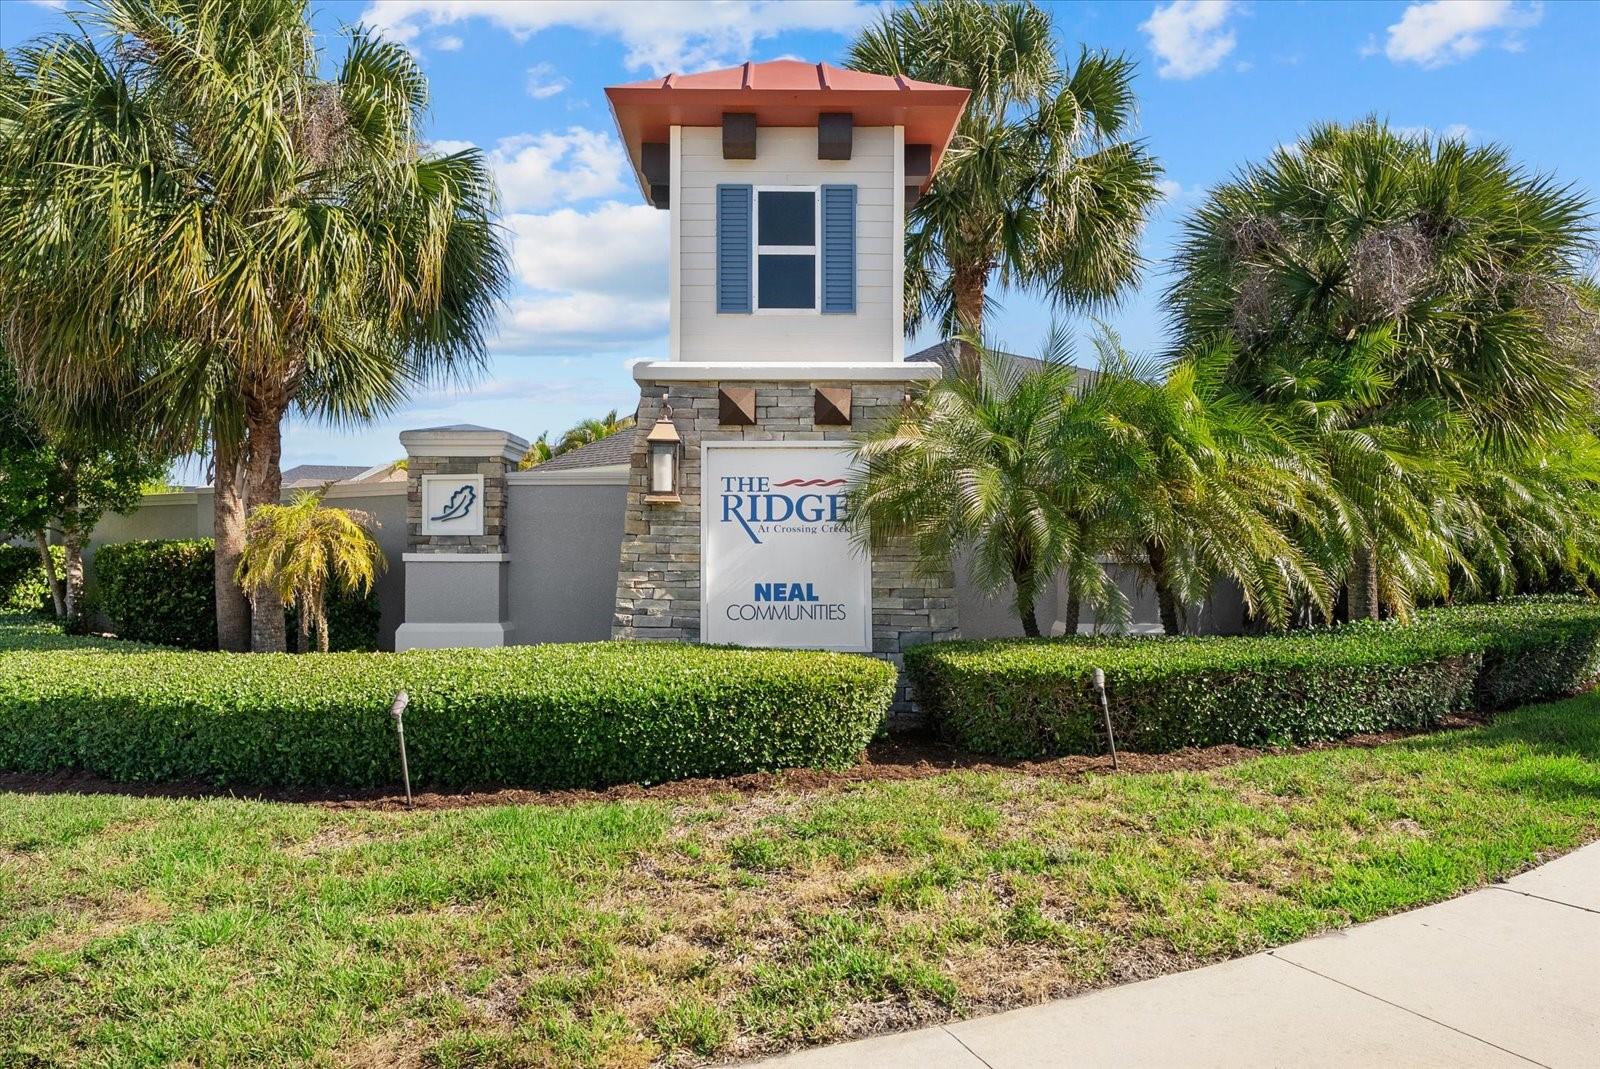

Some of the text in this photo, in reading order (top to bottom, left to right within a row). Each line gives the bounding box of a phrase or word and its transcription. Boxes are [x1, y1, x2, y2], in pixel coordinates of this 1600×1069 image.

[721, 476, 769, 492] THE
[758, 524, 770, 533] At
[774, 525, 817, 534] Crossing
[755, 583, 819, 601] NEAL
[727, 604, 846, 621] COMMUNITIES
